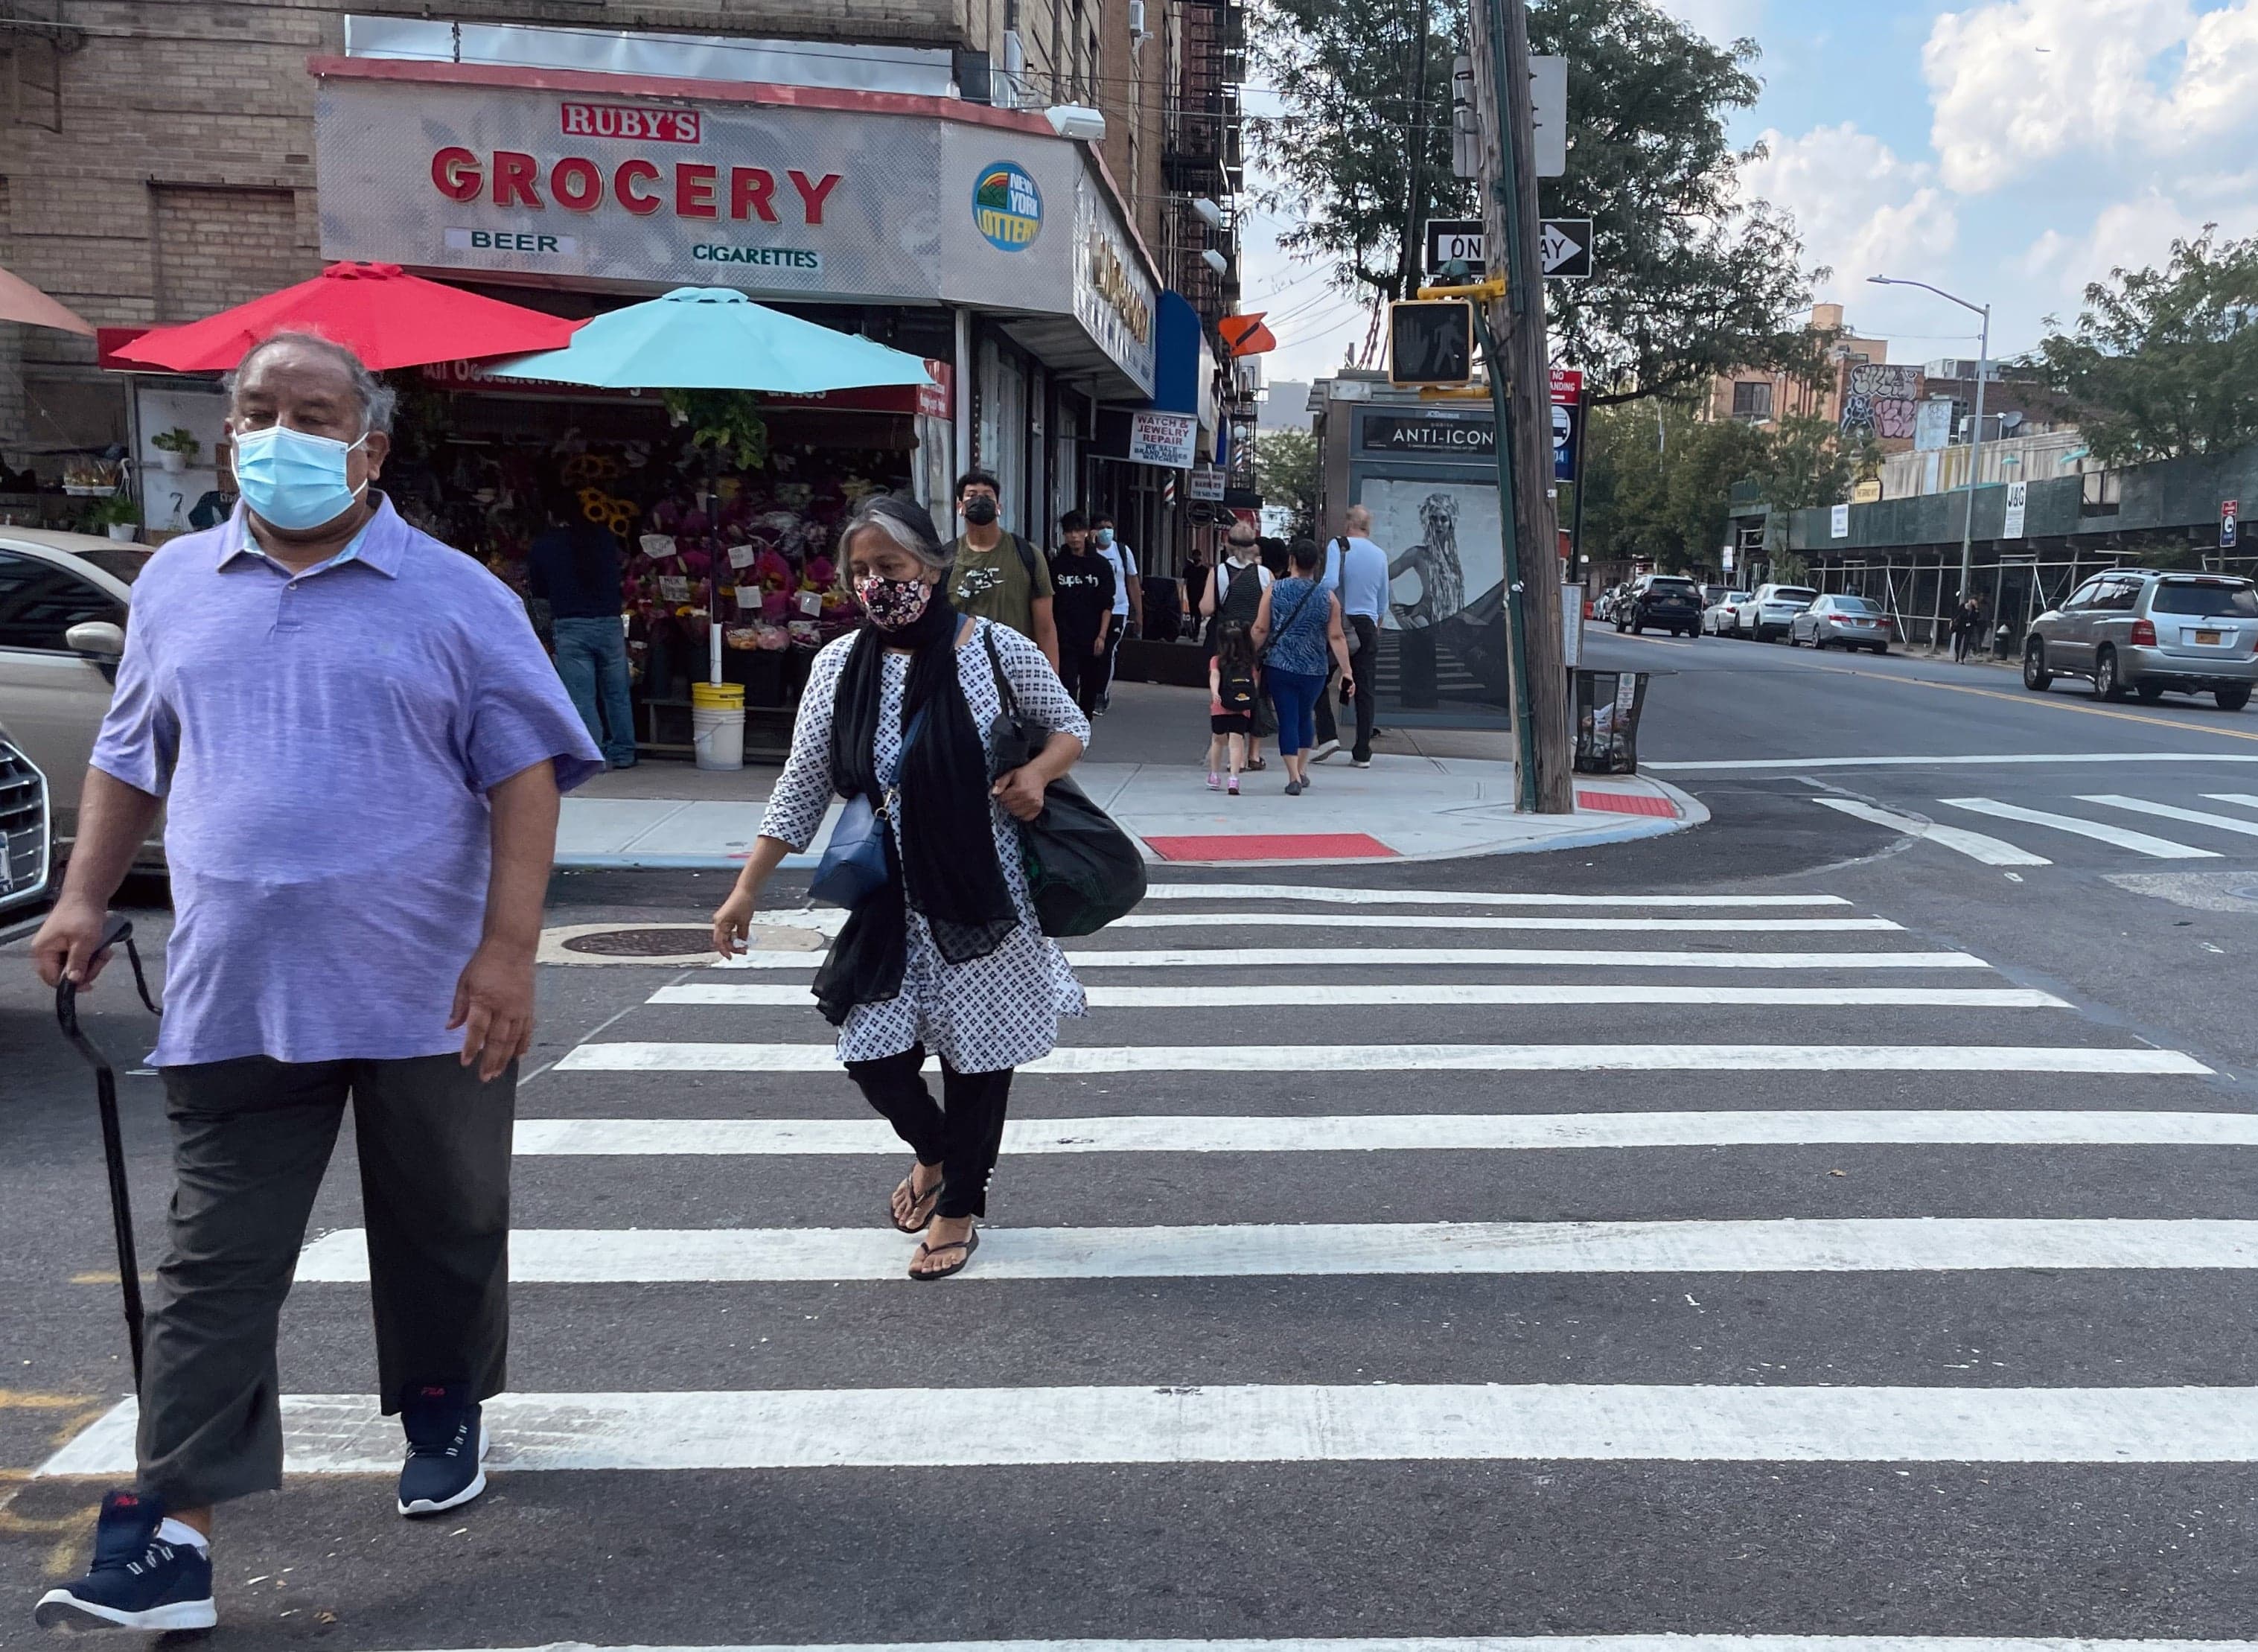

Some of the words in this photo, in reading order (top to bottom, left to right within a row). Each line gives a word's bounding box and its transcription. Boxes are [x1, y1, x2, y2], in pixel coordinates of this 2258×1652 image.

[565, 104, 698, 141] RUBY'S
[431, 146, 843, 226] GROCERY
[1010, 173, 1033, 196] NEW
[1010, 190, 1038, 217] YORK
[977, 208, 1039, 243] LOTTERY
[471, 231, 559, 253] BEER
[1450, 237, 1482, 258] ON
[1541, 237, 1566, 260] AY
[692, 244, 818, 270] CIGARETTES
[1552, 371, 1564, 380] NO
[1550, 382, 1575, 392] ANDING
[1138, 415, 1176, 427] WATCH
[1179, 419, 1188, 429] &
[1138, 424, 1189, 438] JEWELRY
[1143, 433, 1182, 446] REPAIR
[1393, 428, 1493, 445] ANTI-ICON
[1134, 447, 1160, 456] BRAND
[1143, 453, 1179, 463] WATCHES
[1057, 573, 1100, 587] Supey
